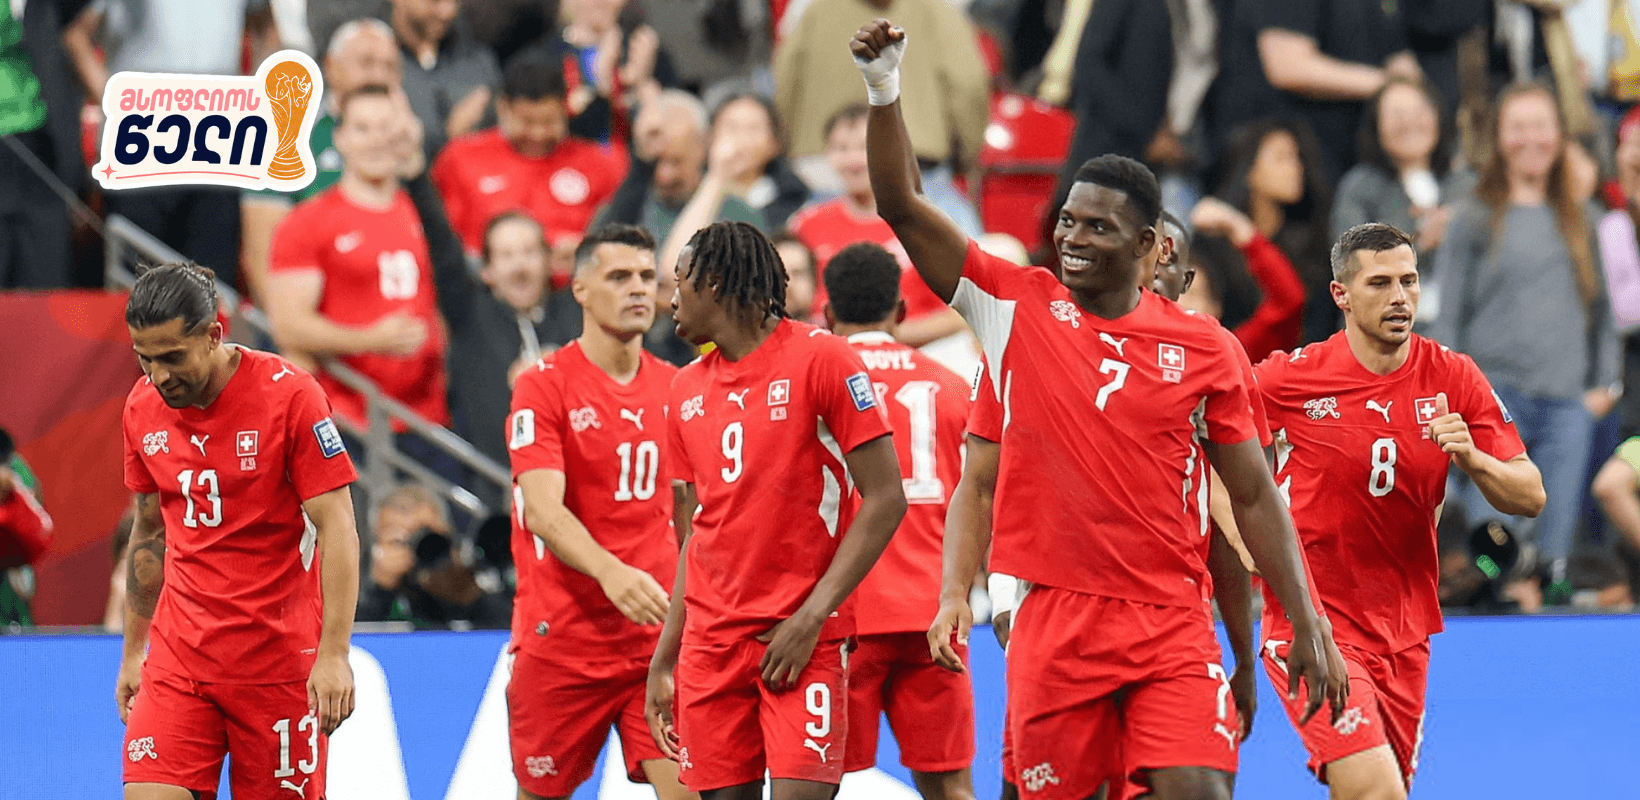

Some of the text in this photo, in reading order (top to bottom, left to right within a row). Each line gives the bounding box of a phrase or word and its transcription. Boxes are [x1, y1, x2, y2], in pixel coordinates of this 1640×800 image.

[1095, 357, 1131, 412] 7
[614, 440, 659, 502] 10
[721, 421, 744, 484] 9
[1368, 437, 1397, 497] 8
[176, 469, 223, 528] 13
[805, 682, 831, 738] 9
[1206, 662, 1231, 721] 7
[272, 714, 319, 778] 13
